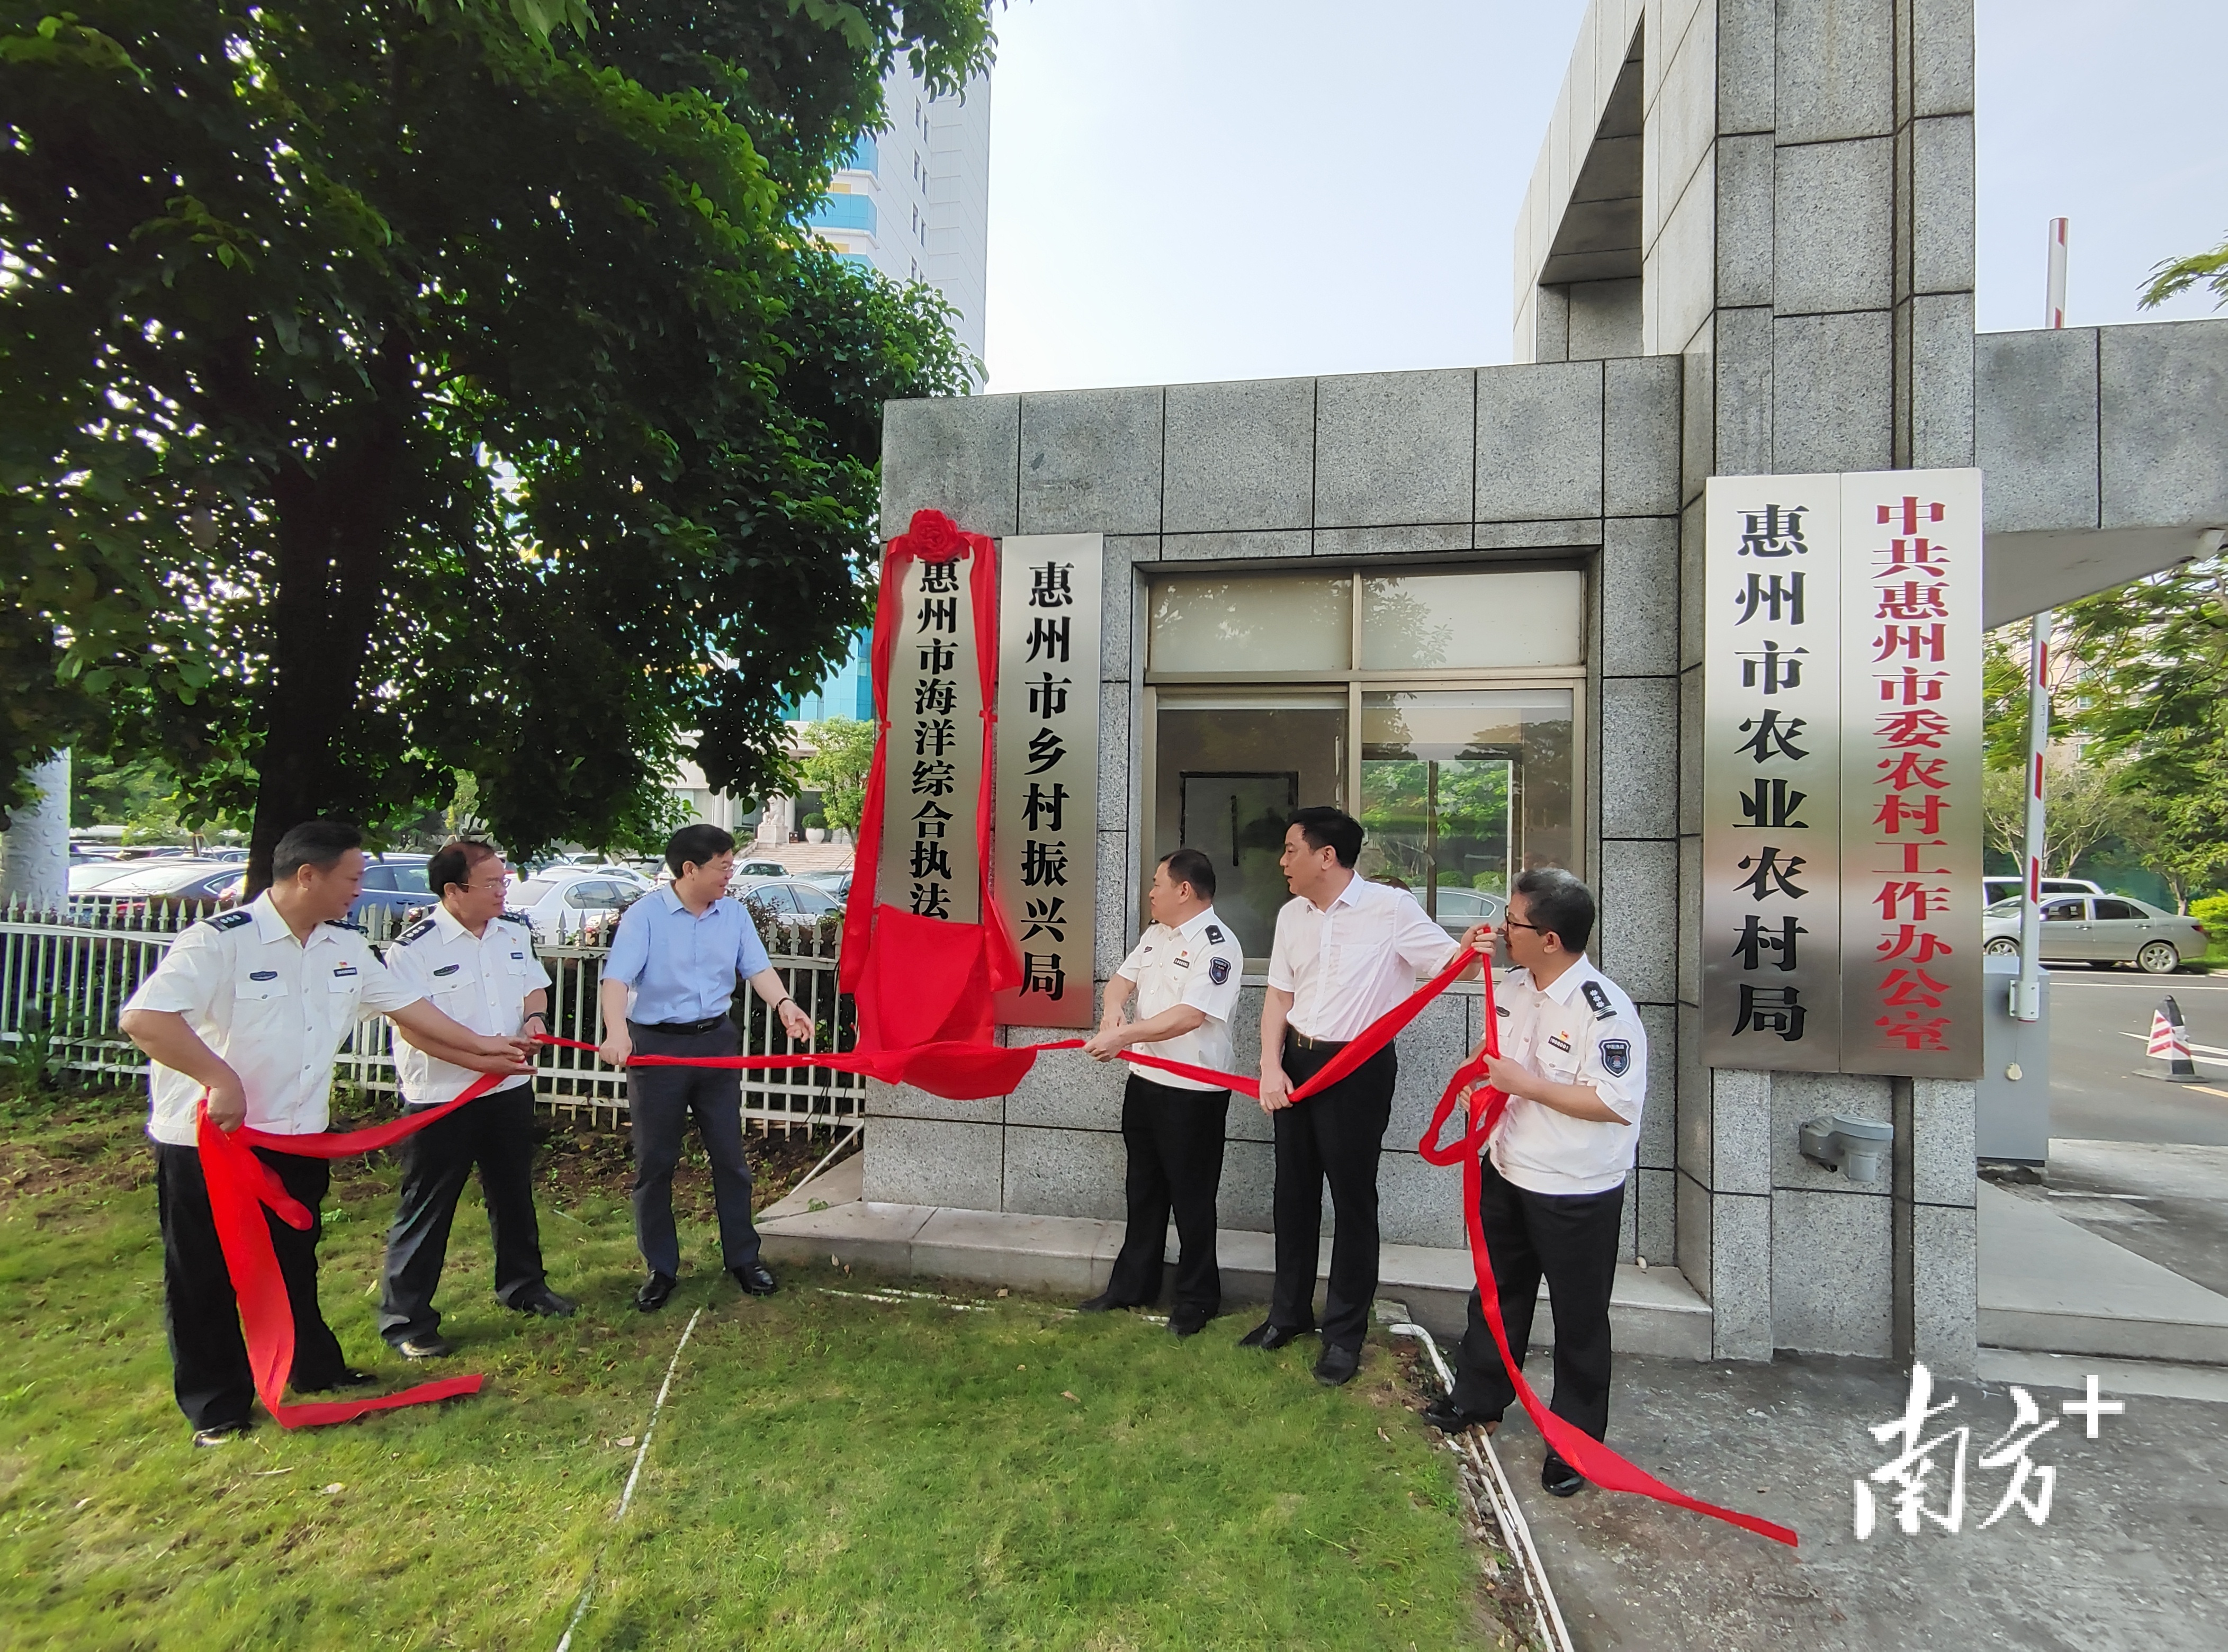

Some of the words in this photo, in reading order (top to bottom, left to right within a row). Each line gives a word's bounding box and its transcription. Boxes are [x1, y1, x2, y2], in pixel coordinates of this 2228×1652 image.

[908, 558, 960, 920] 惠州市海洋综合执法
[1019, 561, 1074, 1001] 惠州市乡村振兴局
[1731, 504, 1810, 1043] 惠州市农业农村局
[1870, 496, 1952, 1052] 中共惠州市委农村工作办公室
